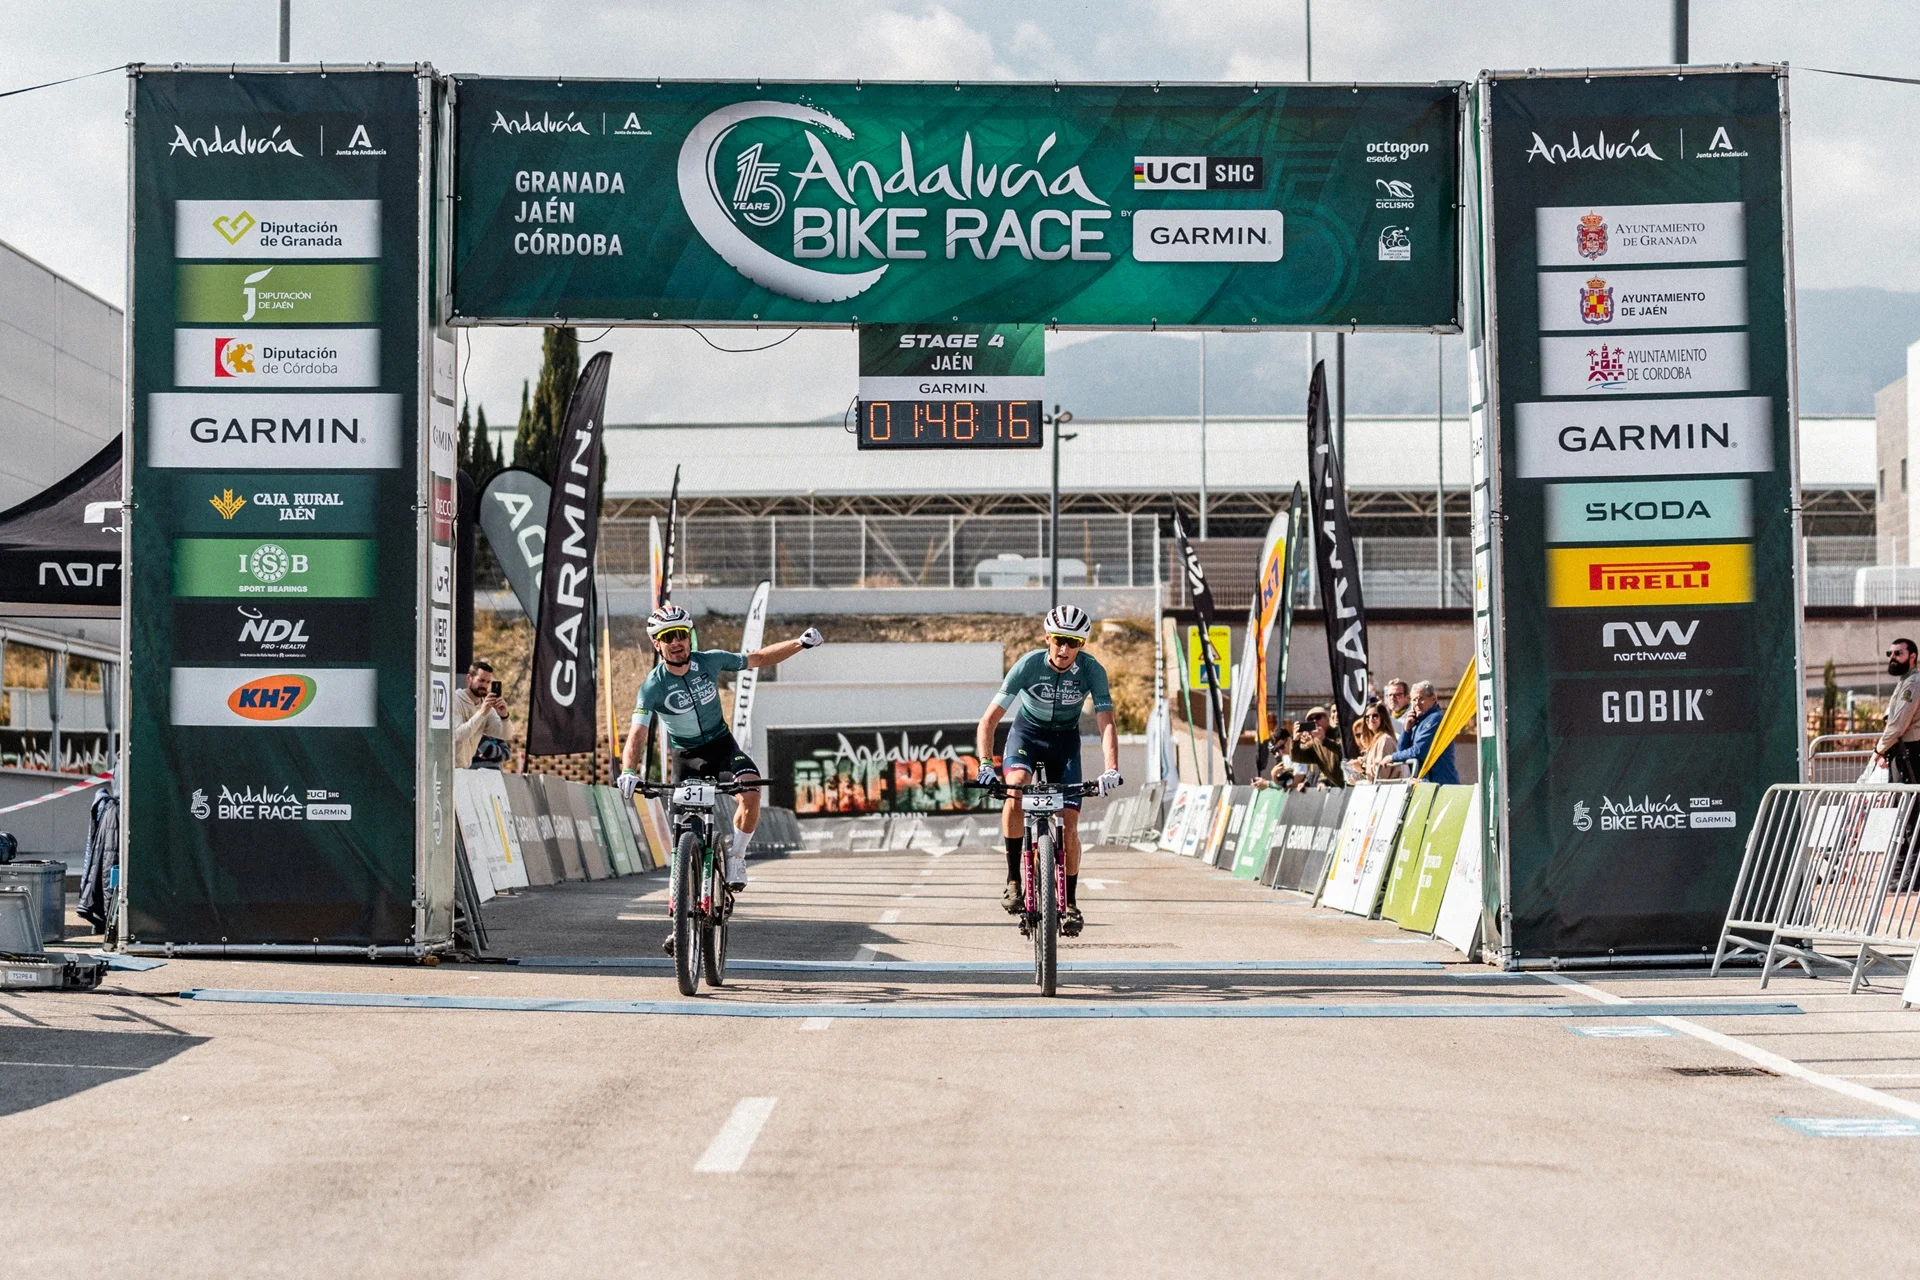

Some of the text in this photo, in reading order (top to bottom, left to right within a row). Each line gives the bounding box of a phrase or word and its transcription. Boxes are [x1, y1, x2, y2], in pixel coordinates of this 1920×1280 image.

[491, 110, 590, 135] Andalucía
[168, 124, 303, 158] Andalucía
[1526, 129, 1663, 164] Andalucía
[1366, 142, 1429, 160] octagon
[1366, 155, 1397, 163] esedos
[1721, 150, 1748, 158] Andalucía
[789, 130, 1110, 206] Andalucía
[1147, 163, 1254, 184] UCI SHC
[515, 170, 625, 194] GRANADA
[733, 143, 786, 226] 15
[514, 196, 575, 224] JAÉN
[733, 202, 770, 210] YEARS
[260, 221, 338, 236] Diputación
[794, 208, 1112, 260] BIKE RACE
[1150, 226, 1266, 245] GARMIN
[260, 236, 342, 247] de Granada
[514, 227, 623, 256] CÓRDOBA
[258, 290, 312, 300] DIPUTACIÓN
[258, 299, 294, 309] DE JAÉN
[1621, 293, 1706, 304] AYUNTAMIENTO
[1621, 304, 1667, 316] DE JAÉN
[900, 334, 1004, 348] STAGE 4
[262, 347, 337, 362] Diputación
[931, 352, 973, 370] JAÉN
[1627, 349, 1707, 363] AYUNTAMIENTO
[262, 361, 338, 374] de Córdoba
[1627, 366, 1692, 381] DE CORDOBA
[919, 384, 985, 394] GARMIN
[190, 418, 359, 444] GARMIN
[433, 425, 453, 451] GMIN
[1558, 422, 1729, 451] GARMIN
[253, 493, 344, 506] CAJA RURAL
[279, 507, 316, 521] JAÉN
[494, 490, 548, 591] AD
[39, 562, 122, 586] nor
[550, 428, 592, 707] GARMIN
[1589, 561, 1710, 590] PIRELLI
[238, 619, 310, 642] NDL
[1613, 652, 1686, 662] northwave
[1602, 689, 1704, 723] GOBIK
[834, 730, 964, 766] Andalucía
[218, 784, 303, 806] Andalucía
[684, 788, 703, 801] 3-1
[1033, 796, 1053, 806] 3-2
[218, 805, 303, 820] BIKE RACE
[312, 808, 346, 816] GARMIN
[1600, 794, 1686, 816] Andalucía
[1602, 814, 1687, 830] BIKE RACE
